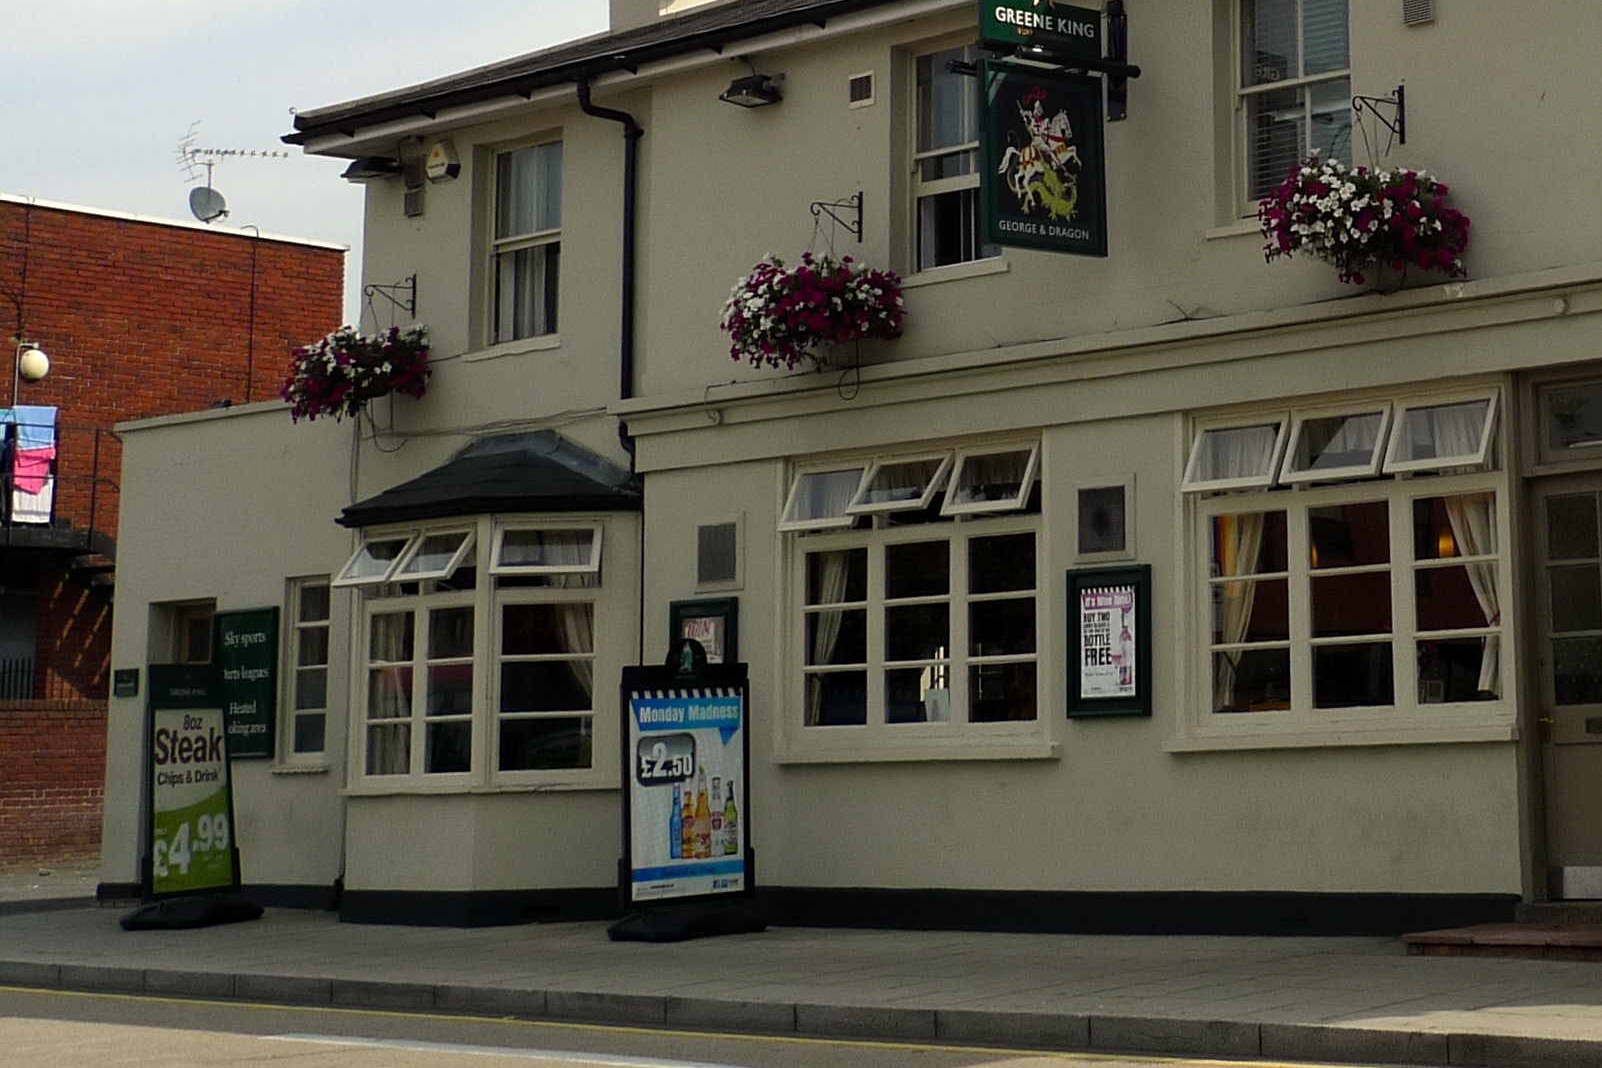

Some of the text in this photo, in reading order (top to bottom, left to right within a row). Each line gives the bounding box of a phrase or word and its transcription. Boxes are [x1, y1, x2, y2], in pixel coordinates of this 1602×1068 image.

[995, 6, 1054, 31] GREENE
[1057, 17, 1095, 38] KING
[999, 219, 1089, 240] GEORGE & DRAGON
[224, 630, 266, 648] Sky sports
[1085, 648, 1112, 666] FREE
[182, 714, 203, 731] 8oz
[640, 704, 739, 723] Monday Madness
[227, 720, 249, 737] oking
[155, 726, 223, 766] Steak
[641, 742, 693, 779] £2.50
[157, 771, 184, 788] Chips
[185, 770, 193, 784] &
[154, 813, 229, 877] £4.99
